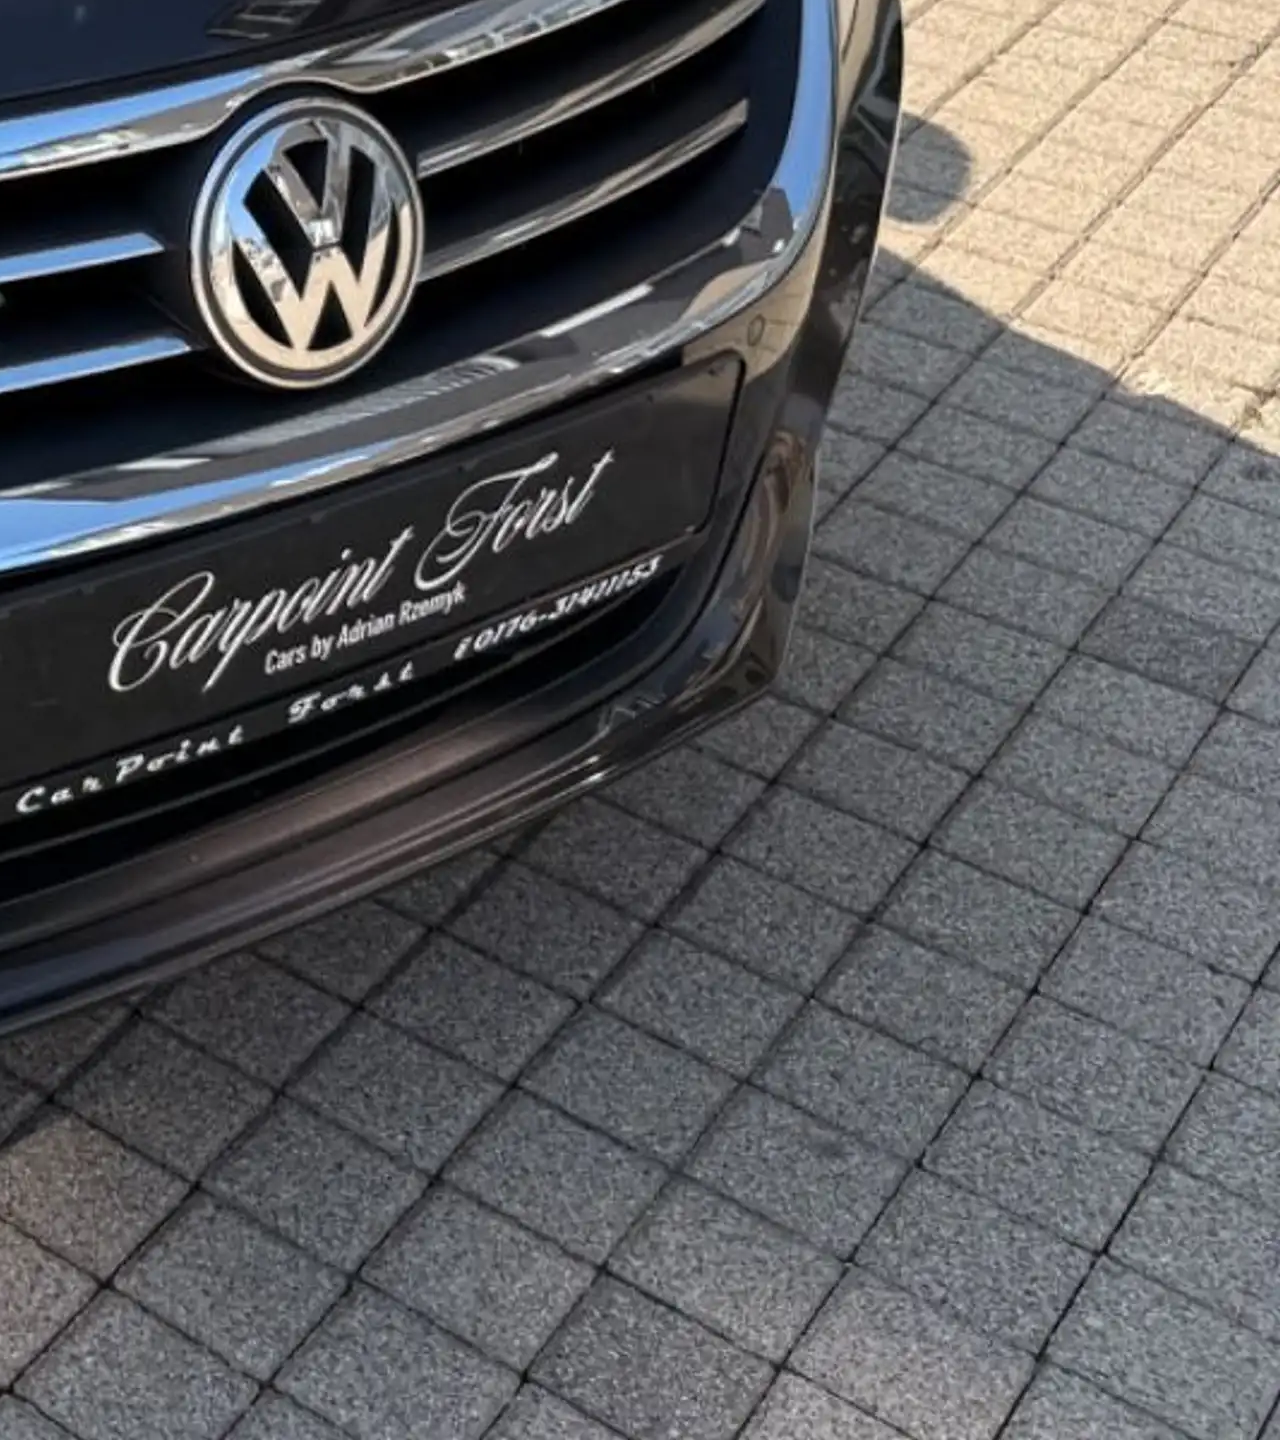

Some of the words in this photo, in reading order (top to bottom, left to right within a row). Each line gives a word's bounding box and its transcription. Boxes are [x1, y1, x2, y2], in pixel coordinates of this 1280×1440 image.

[107, 525, 416, 694] Carpoint
[413, 447, 616, 592] Forst
[264, 645, 307, 675] Cars
[310, 633, 336, 661] by
[335, 612, 396, 649] Adrian
[398, 580, 466, 626] Rzemyk
